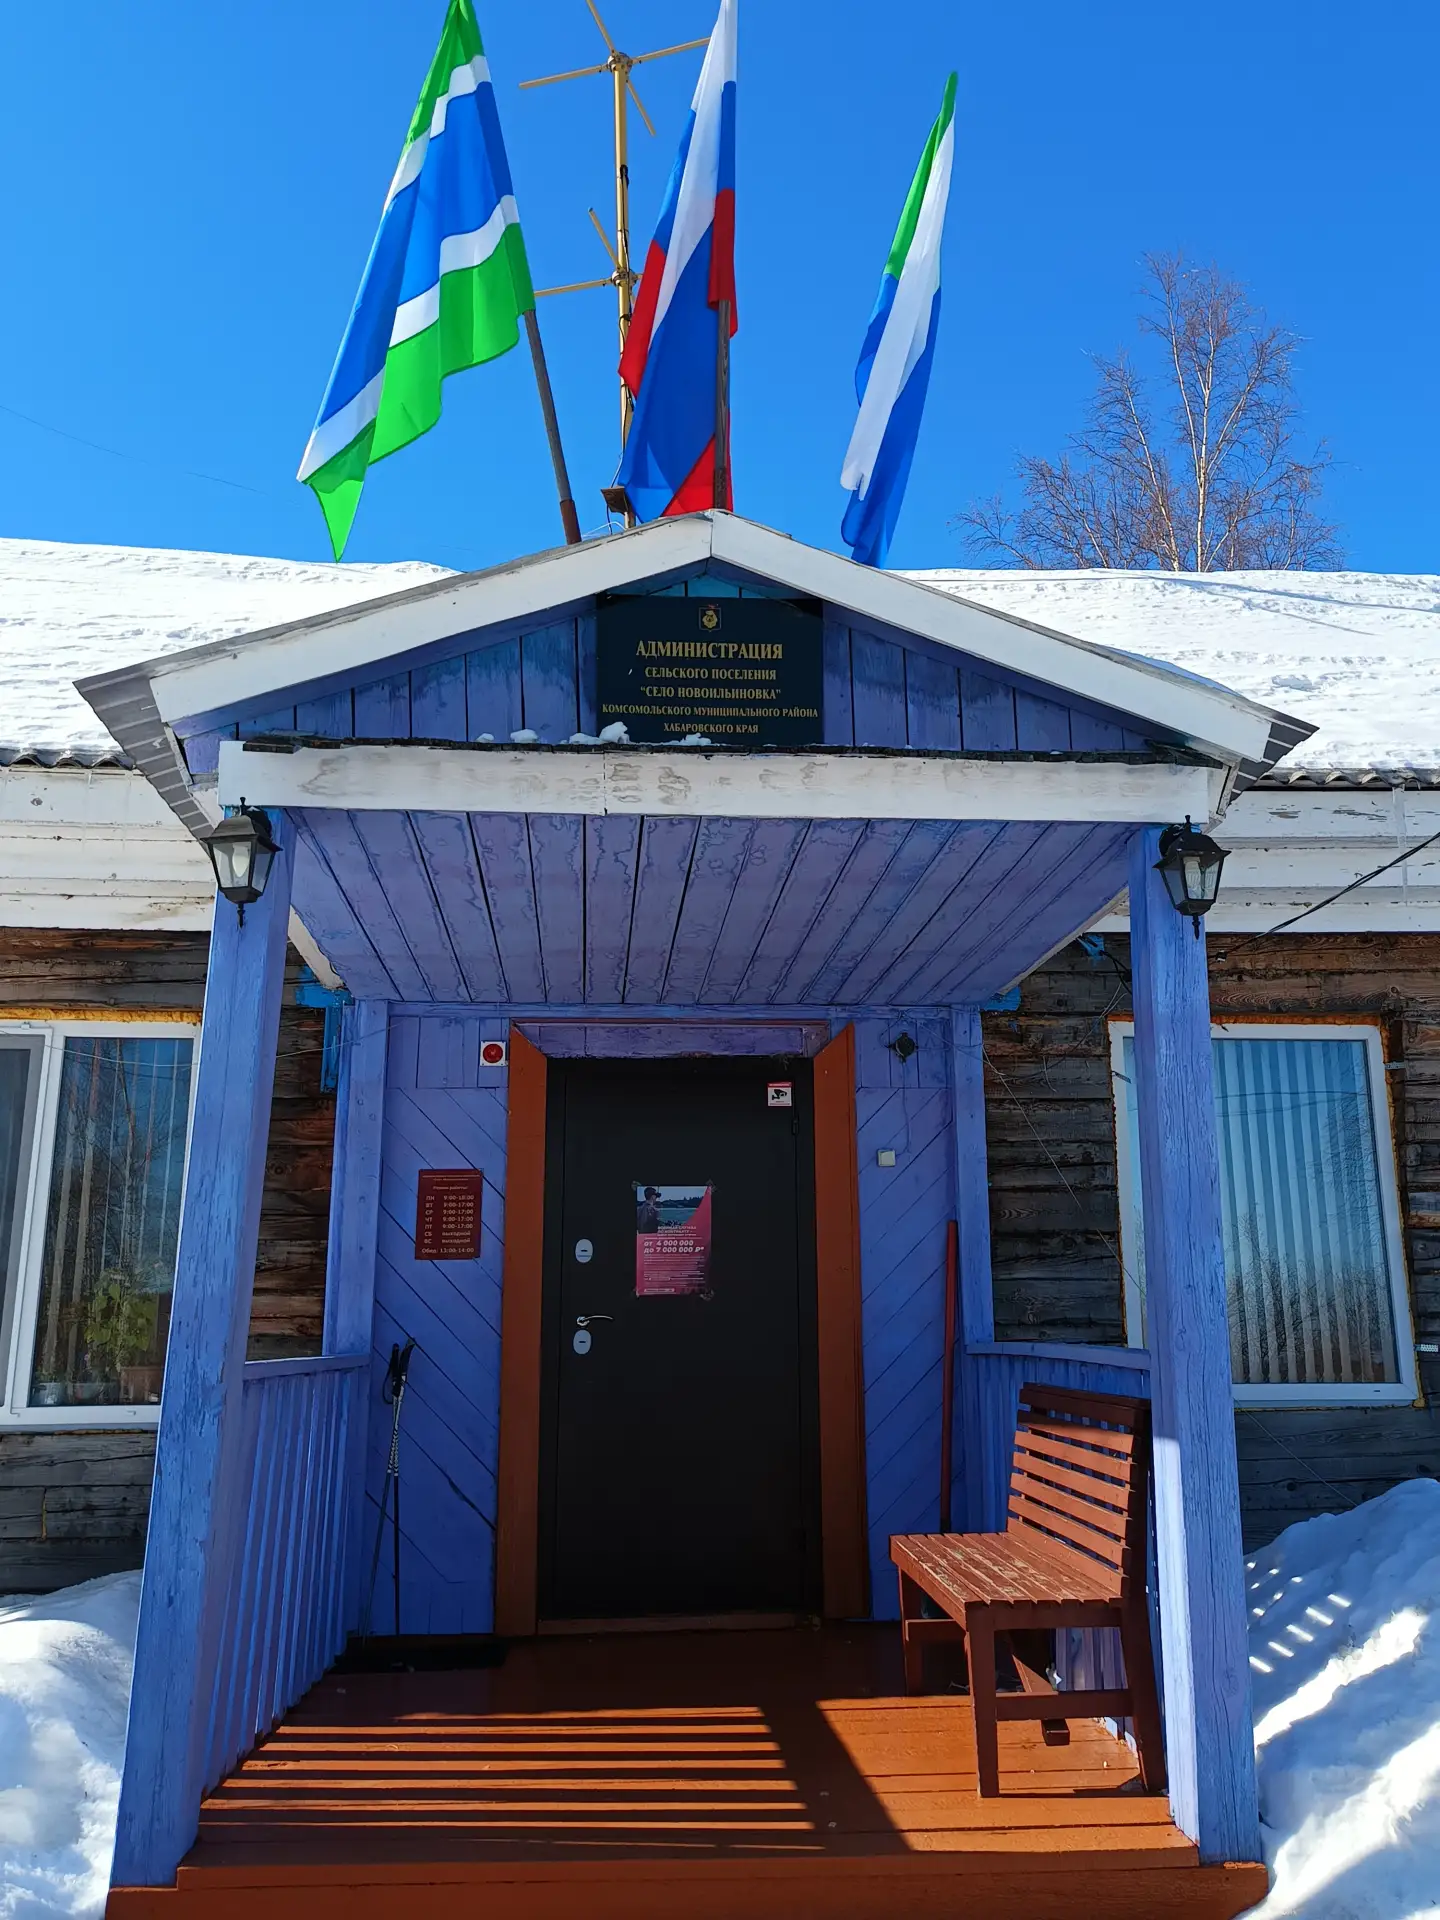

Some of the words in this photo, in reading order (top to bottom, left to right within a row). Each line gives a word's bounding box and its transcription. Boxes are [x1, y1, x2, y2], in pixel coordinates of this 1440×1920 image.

[636, 640, 783, 661] АДМИНИСТРАЦИЯ
[645, 666, 709, 679] СЕЛЬСКОГО
[712, 668, 777, 680] ПОСЕЛЕНИЯ
[640, 686, 675, 698] “СЕЛО
[678, 687, 781, 700] НОВОИЛЬИНОВКА”
[602, 704, 691, 716] КОМСОМОЛЬСКОГО
[693, 706, 780, 718] МУНИЦИПАЛЬНОГО
[782, 706, 818, 718] РАЙОНА
[663, 722, 734, 734] ХАБАРОВСКОГО
[736, 723, 759, 734] КРАЯ
